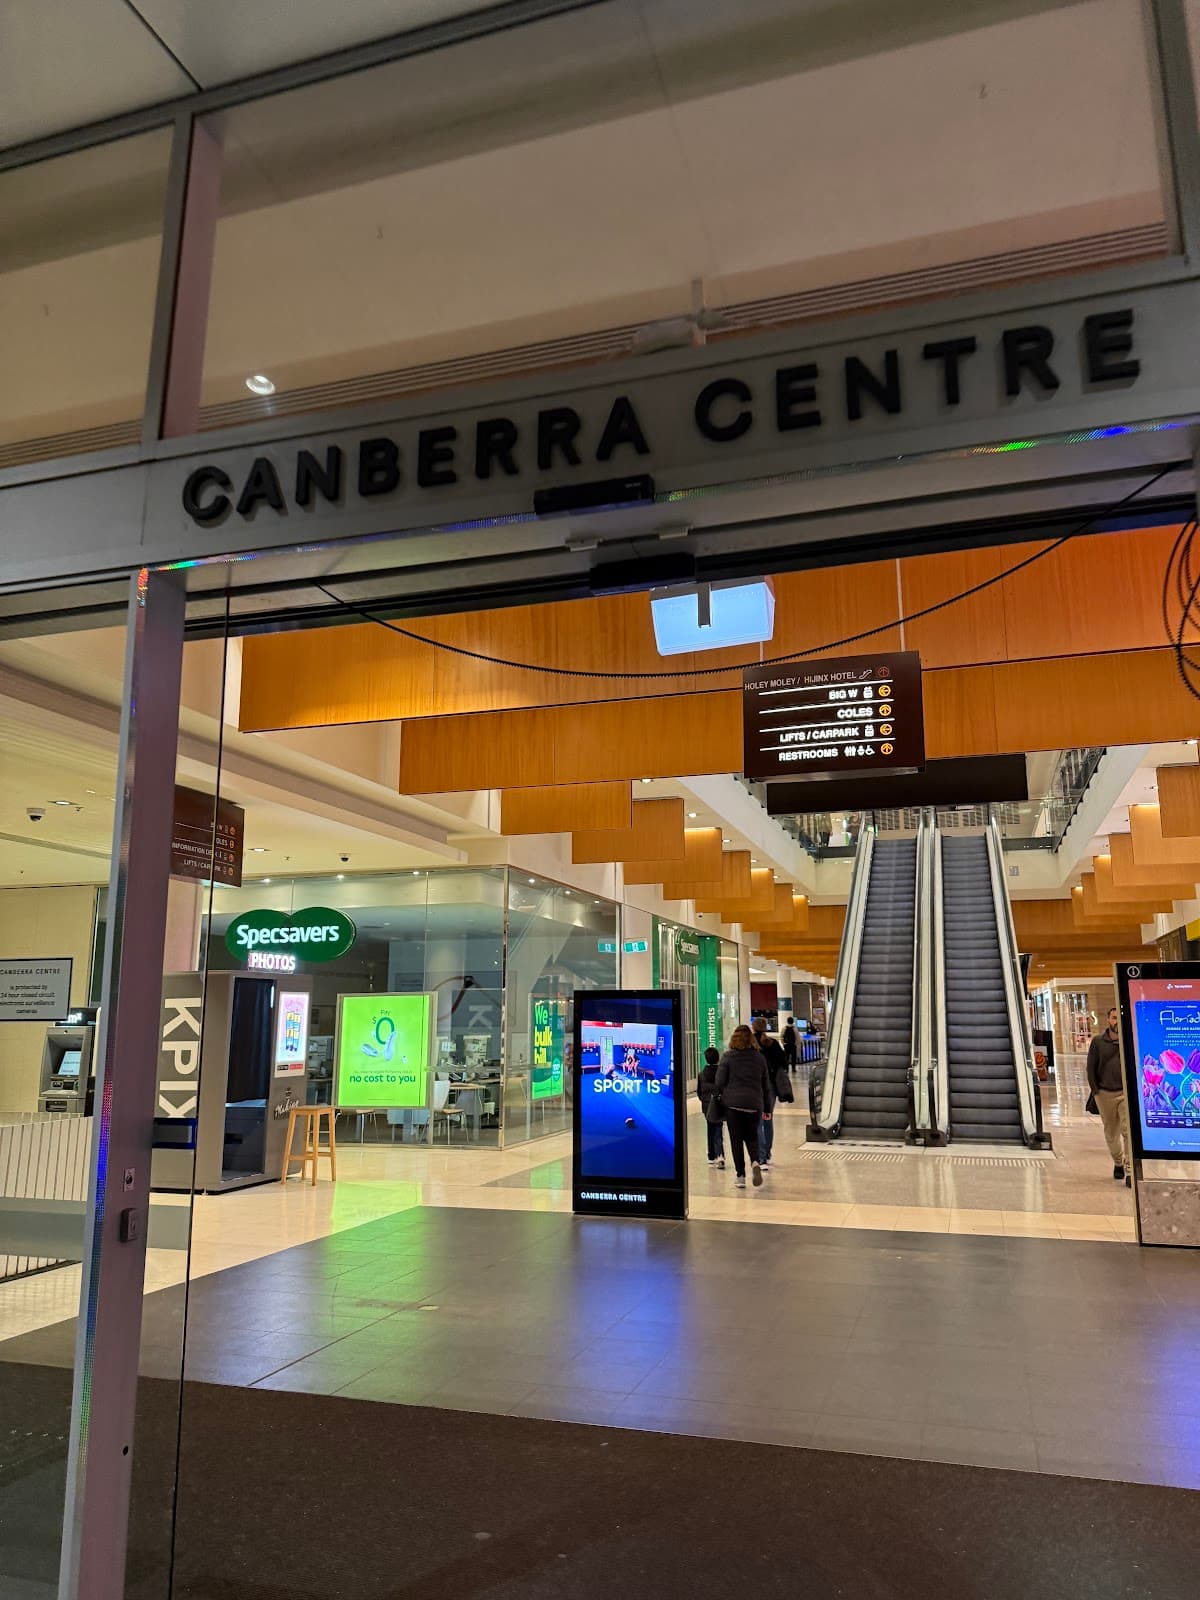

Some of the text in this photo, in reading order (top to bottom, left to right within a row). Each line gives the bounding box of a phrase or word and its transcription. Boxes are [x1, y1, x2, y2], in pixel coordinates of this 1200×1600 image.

[182, 309, 1140, 523] CANBERRA CENTRE
[744, 680, 769, 690] HOLEY
[770, 678, 796, 688] MOLEY
[804, 674, 829, 684] HIJINX
[830, 672, 856, 681] HOTEL
[829, 689, 858, 700] BIG W
[837, 707, 873, 719] COLES
[780, 730, 806, 743] LIFTS
[812, 727, 859, 740] CARPARK
[779, 748, 838, 761] RESTROOMS
[171, 842, 205, 853] INFORMATION
[215, 838, 228, 846] OLES
[183, 859, 197, 867] LIFTS
[236, 924, 340, 949] Specsavers
[250, 952, 296, 971] PHOTOS
[535, 1005, 548, 1025] We
[535, 1026, 552, 1047] bulk
[349, 1075, 416, 1085] no cost to you
[593, 1079, 660, 1094] SPORT IS
[581, 1191, 647, 1202] CANBERRA CENTRE
